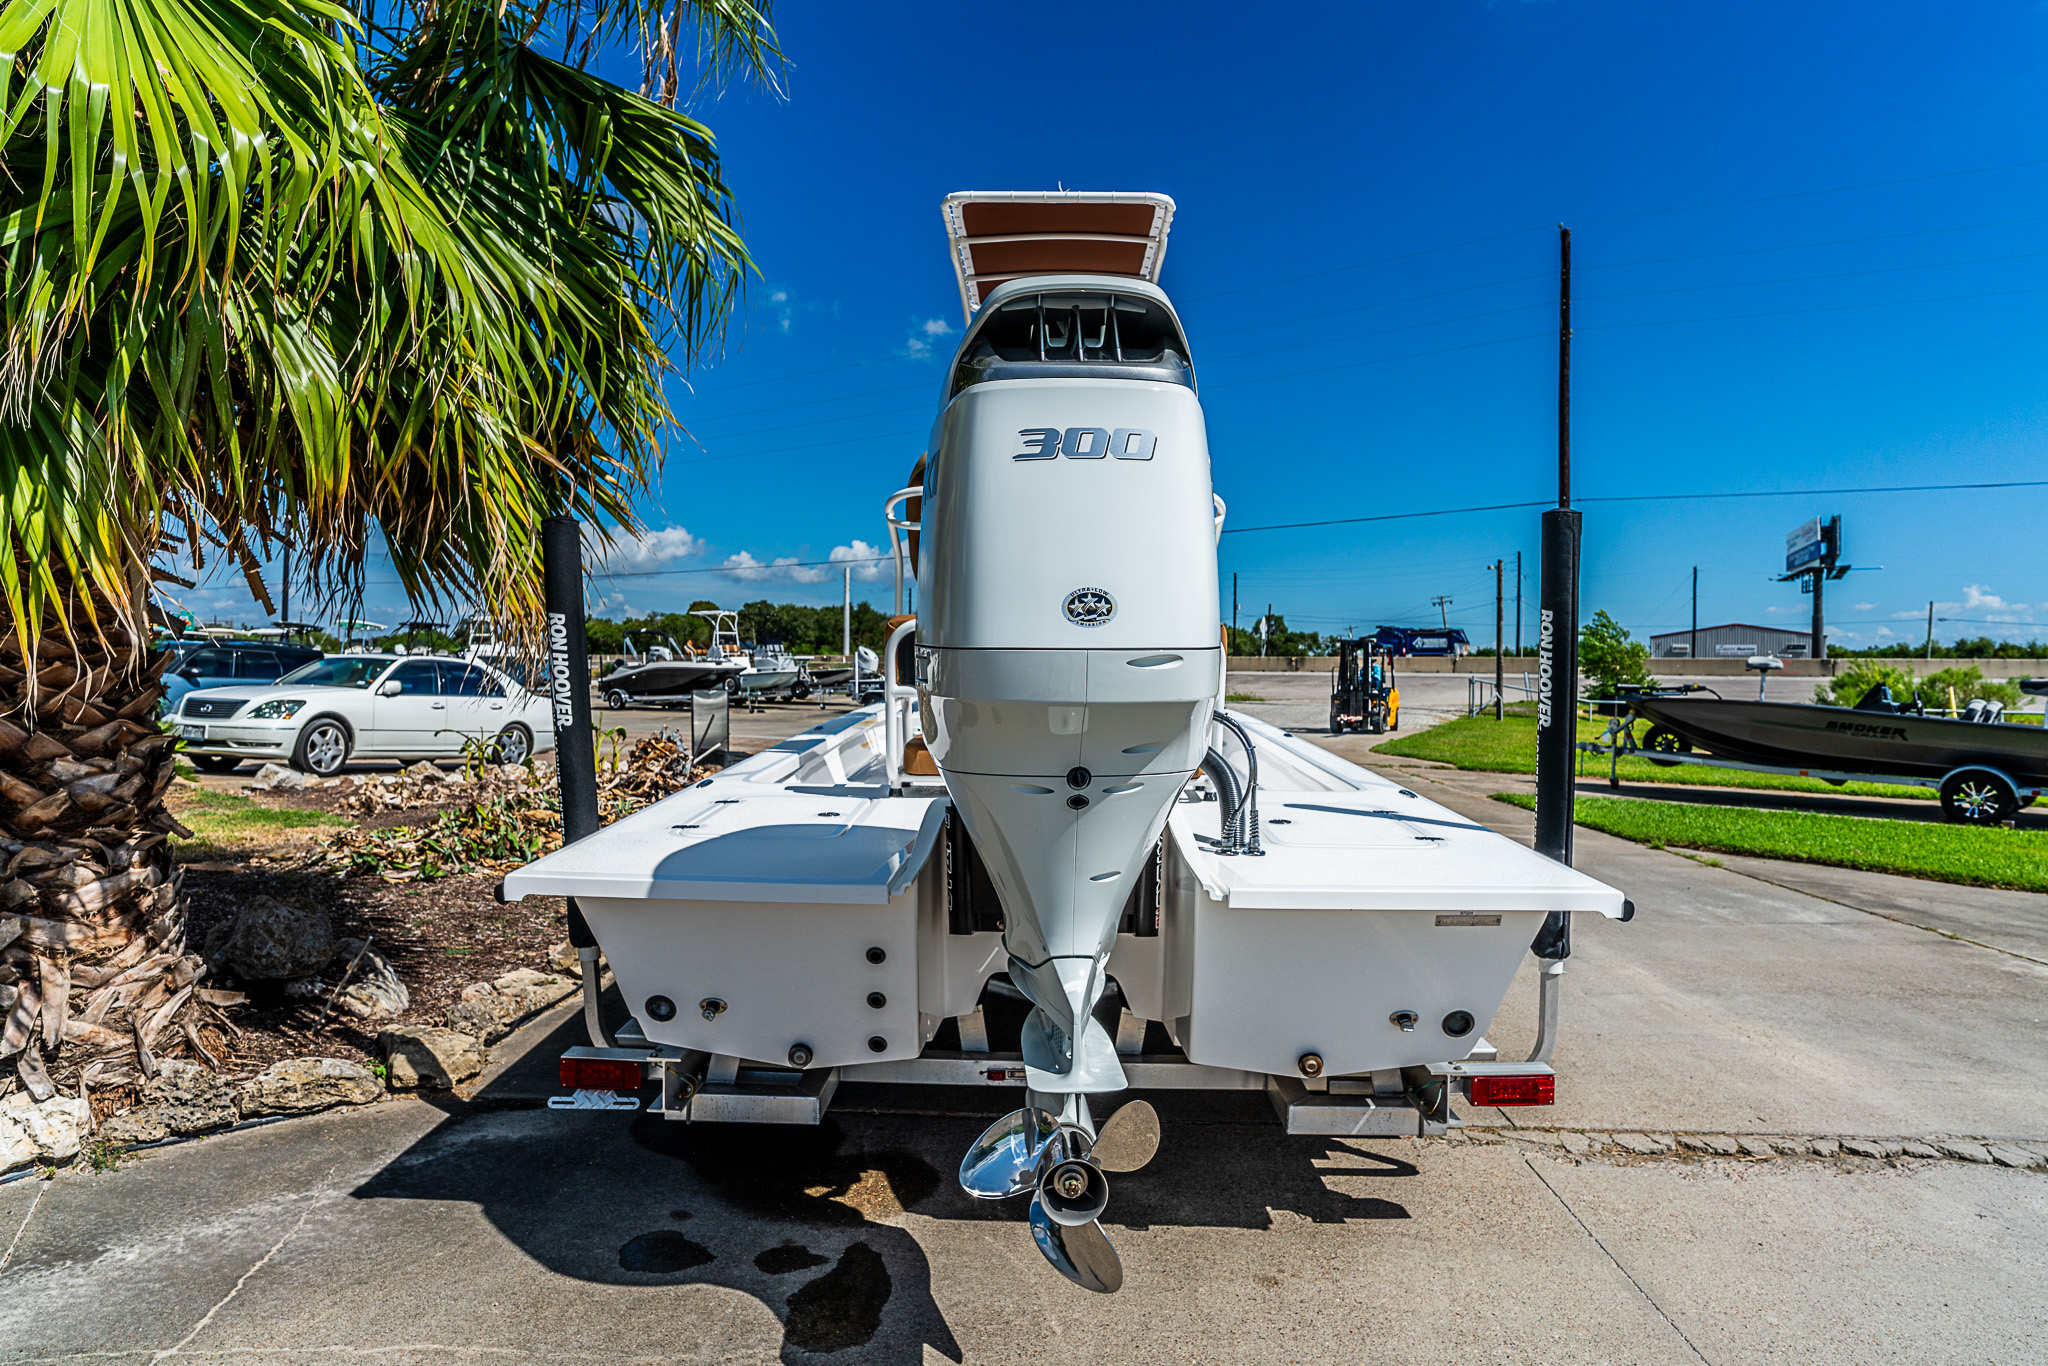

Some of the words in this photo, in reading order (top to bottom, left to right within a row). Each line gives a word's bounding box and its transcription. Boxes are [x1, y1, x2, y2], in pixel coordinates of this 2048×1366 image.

[1012, 427, 1158, 461] 300
[548, 612, 568, 651] RON
[1540, 609, 1554, 649] RON
[552, 652, 573, 730] HOOVER
[1539, 651, 1553, 729] HOOVER
[1826, 721, 1908, 741] SMOKER
